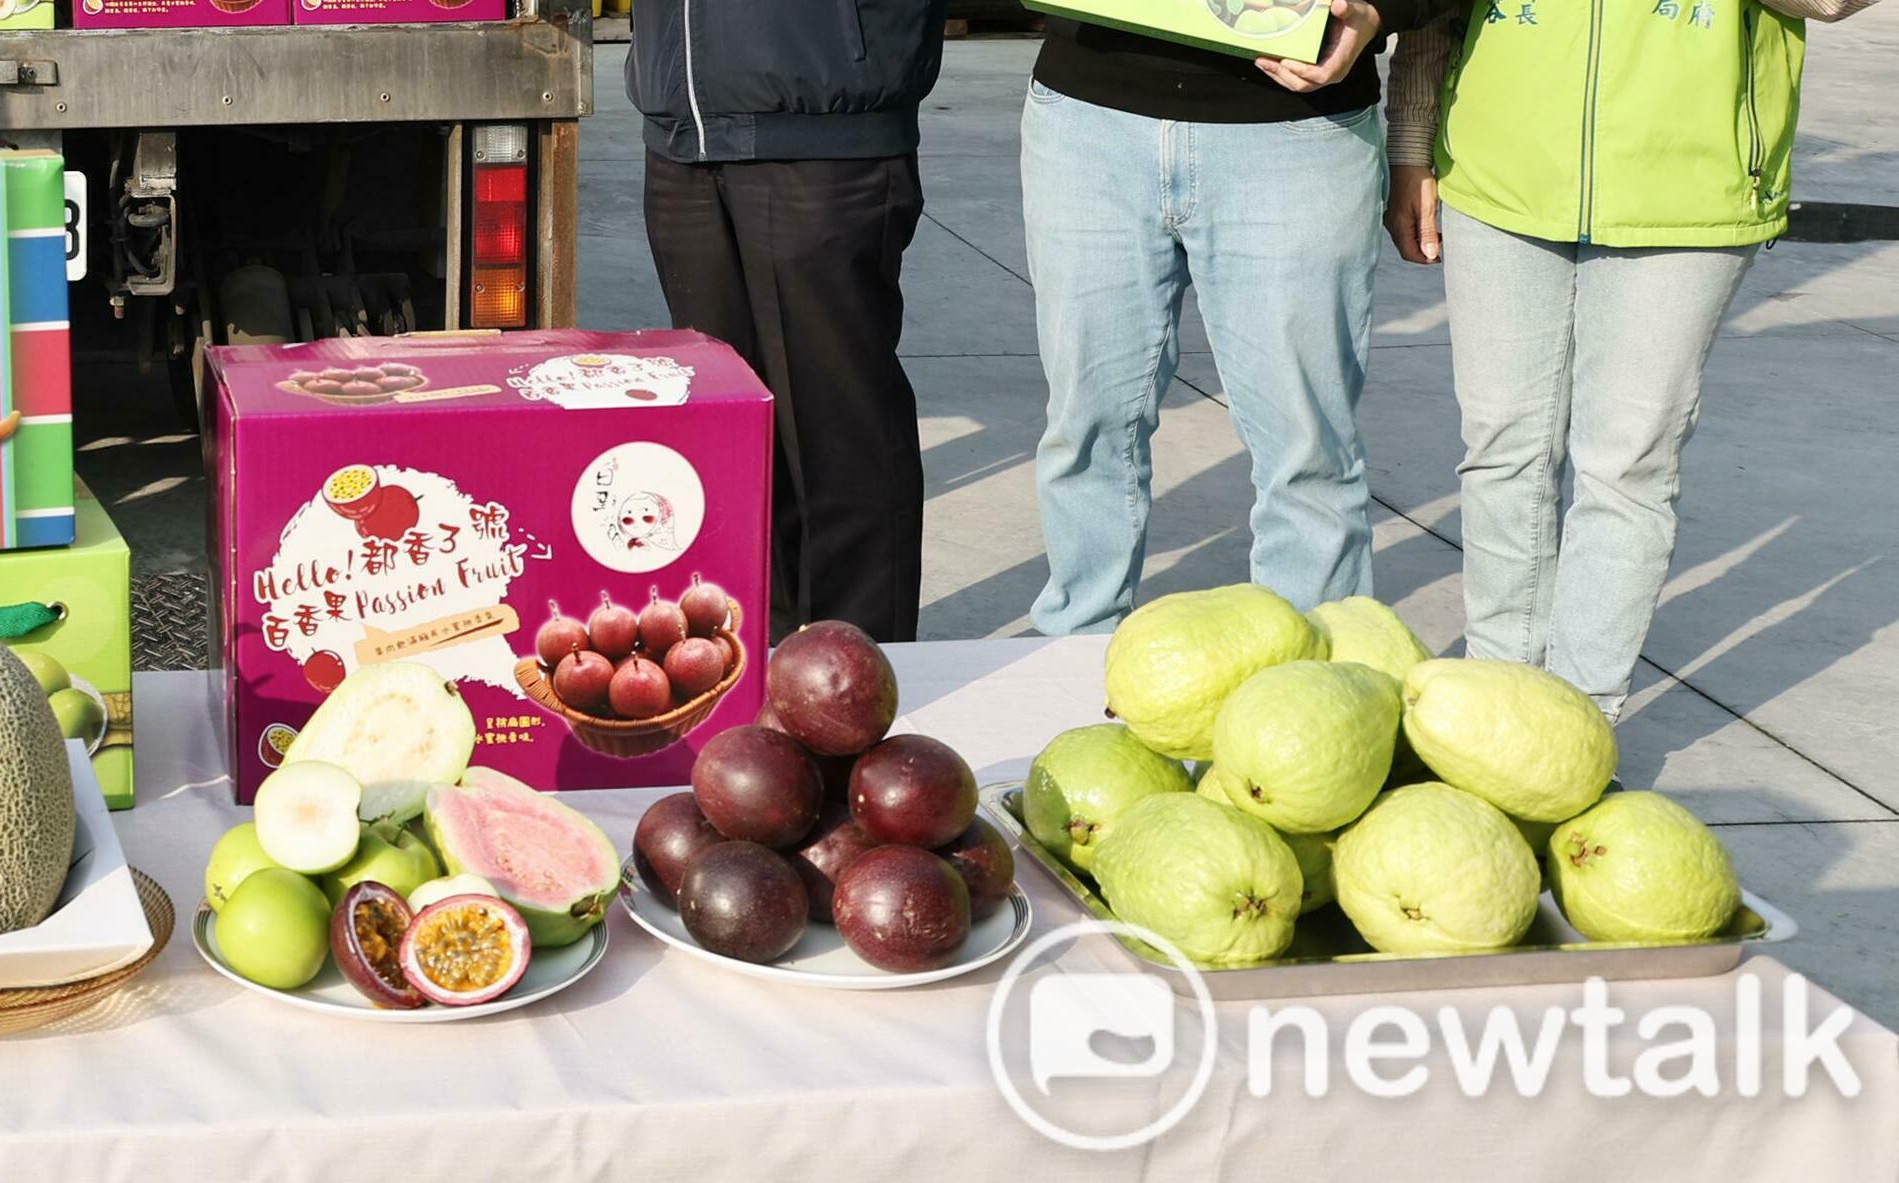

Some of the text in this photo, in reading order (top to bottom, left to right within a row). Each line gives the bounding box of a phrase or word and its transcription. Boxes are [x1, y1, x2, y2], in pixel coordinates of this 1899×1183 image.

[257, 550, 354, 601] Hello!
[266, 549, 524, 647] 百香果 Passion Fruit
